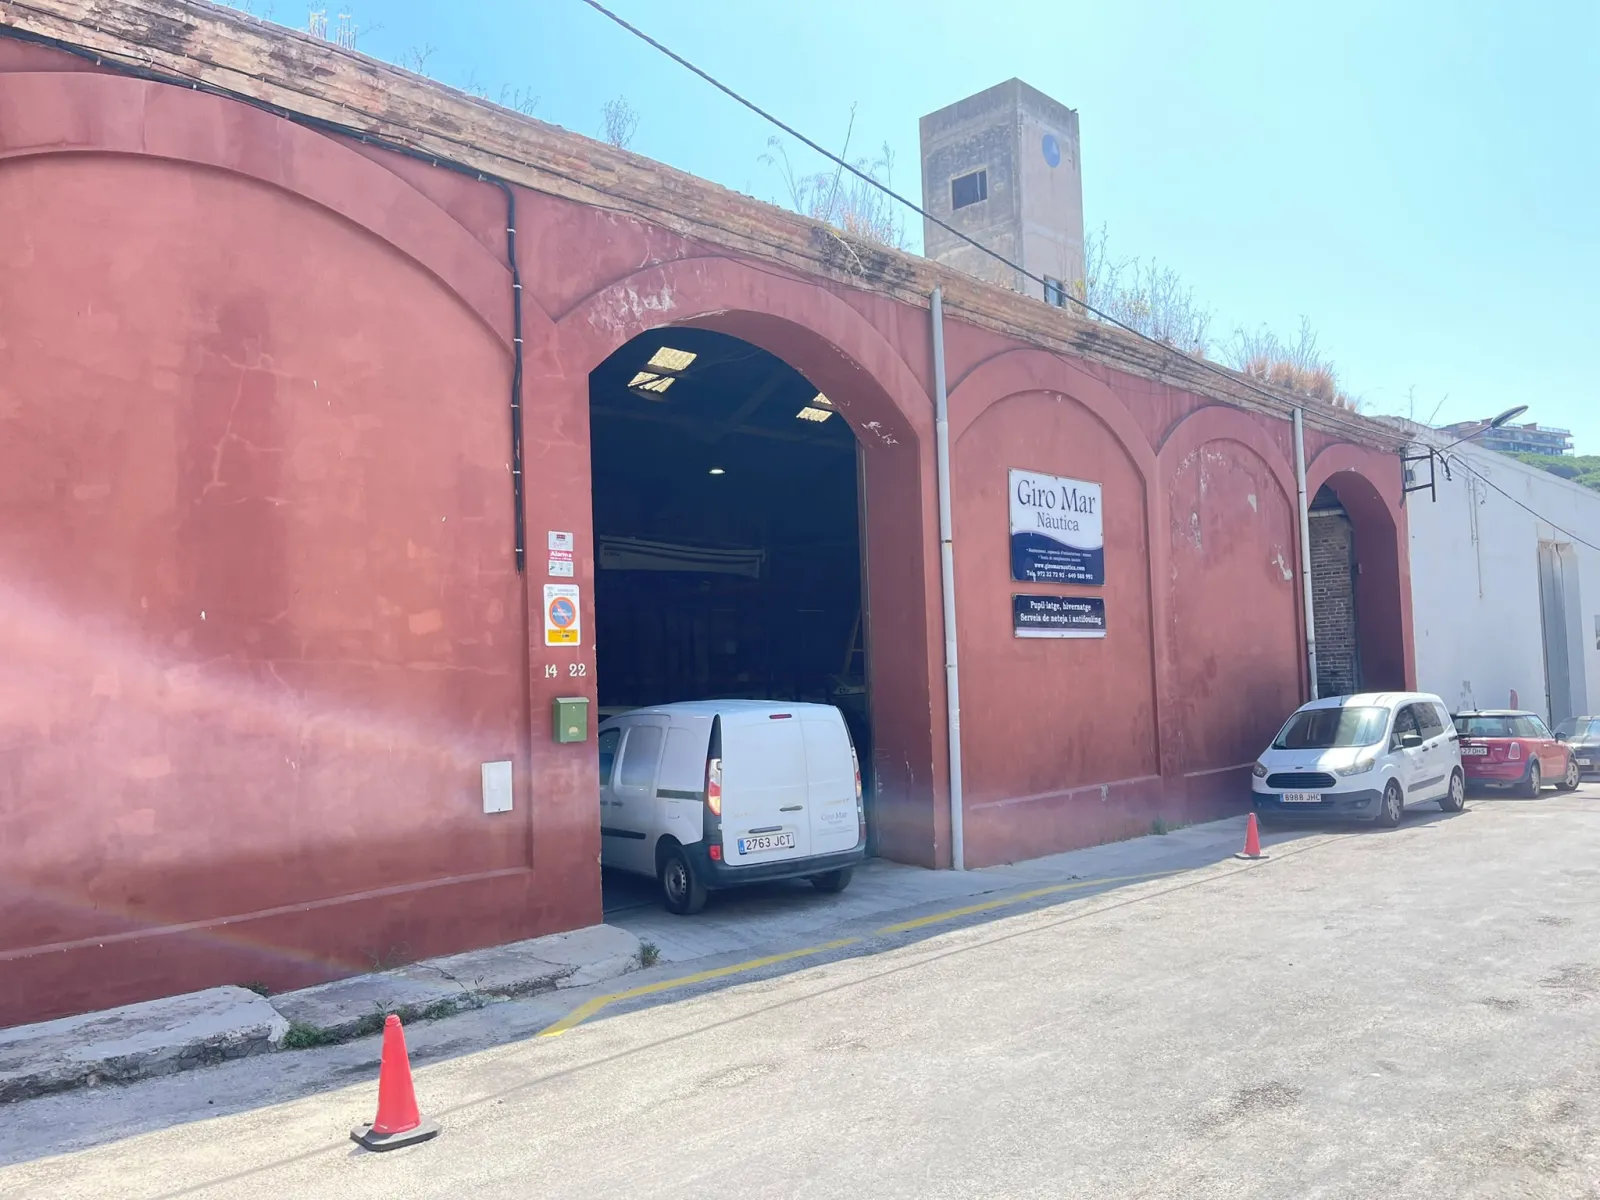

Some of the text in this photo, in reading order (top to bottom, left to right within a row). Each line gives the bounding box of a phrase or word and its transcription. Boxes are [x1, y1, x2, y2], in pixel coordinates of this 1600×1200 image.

[1017, 480, 1096, 514] Giro Mar
[1037, 512, 1080, 531] Nàutica
[1063, 601, 1092, 612] hivernatge
[1020, 613, 1041, 622] Serveis
[1042, 614, 1049, 622] de
[1050, 614, 1068, 624] neteja
[1072, 615, 1102, 625] antifouling
[544, 664, 586, 678] 14 22
[746, 834, 791, 850] 2763 JCT
